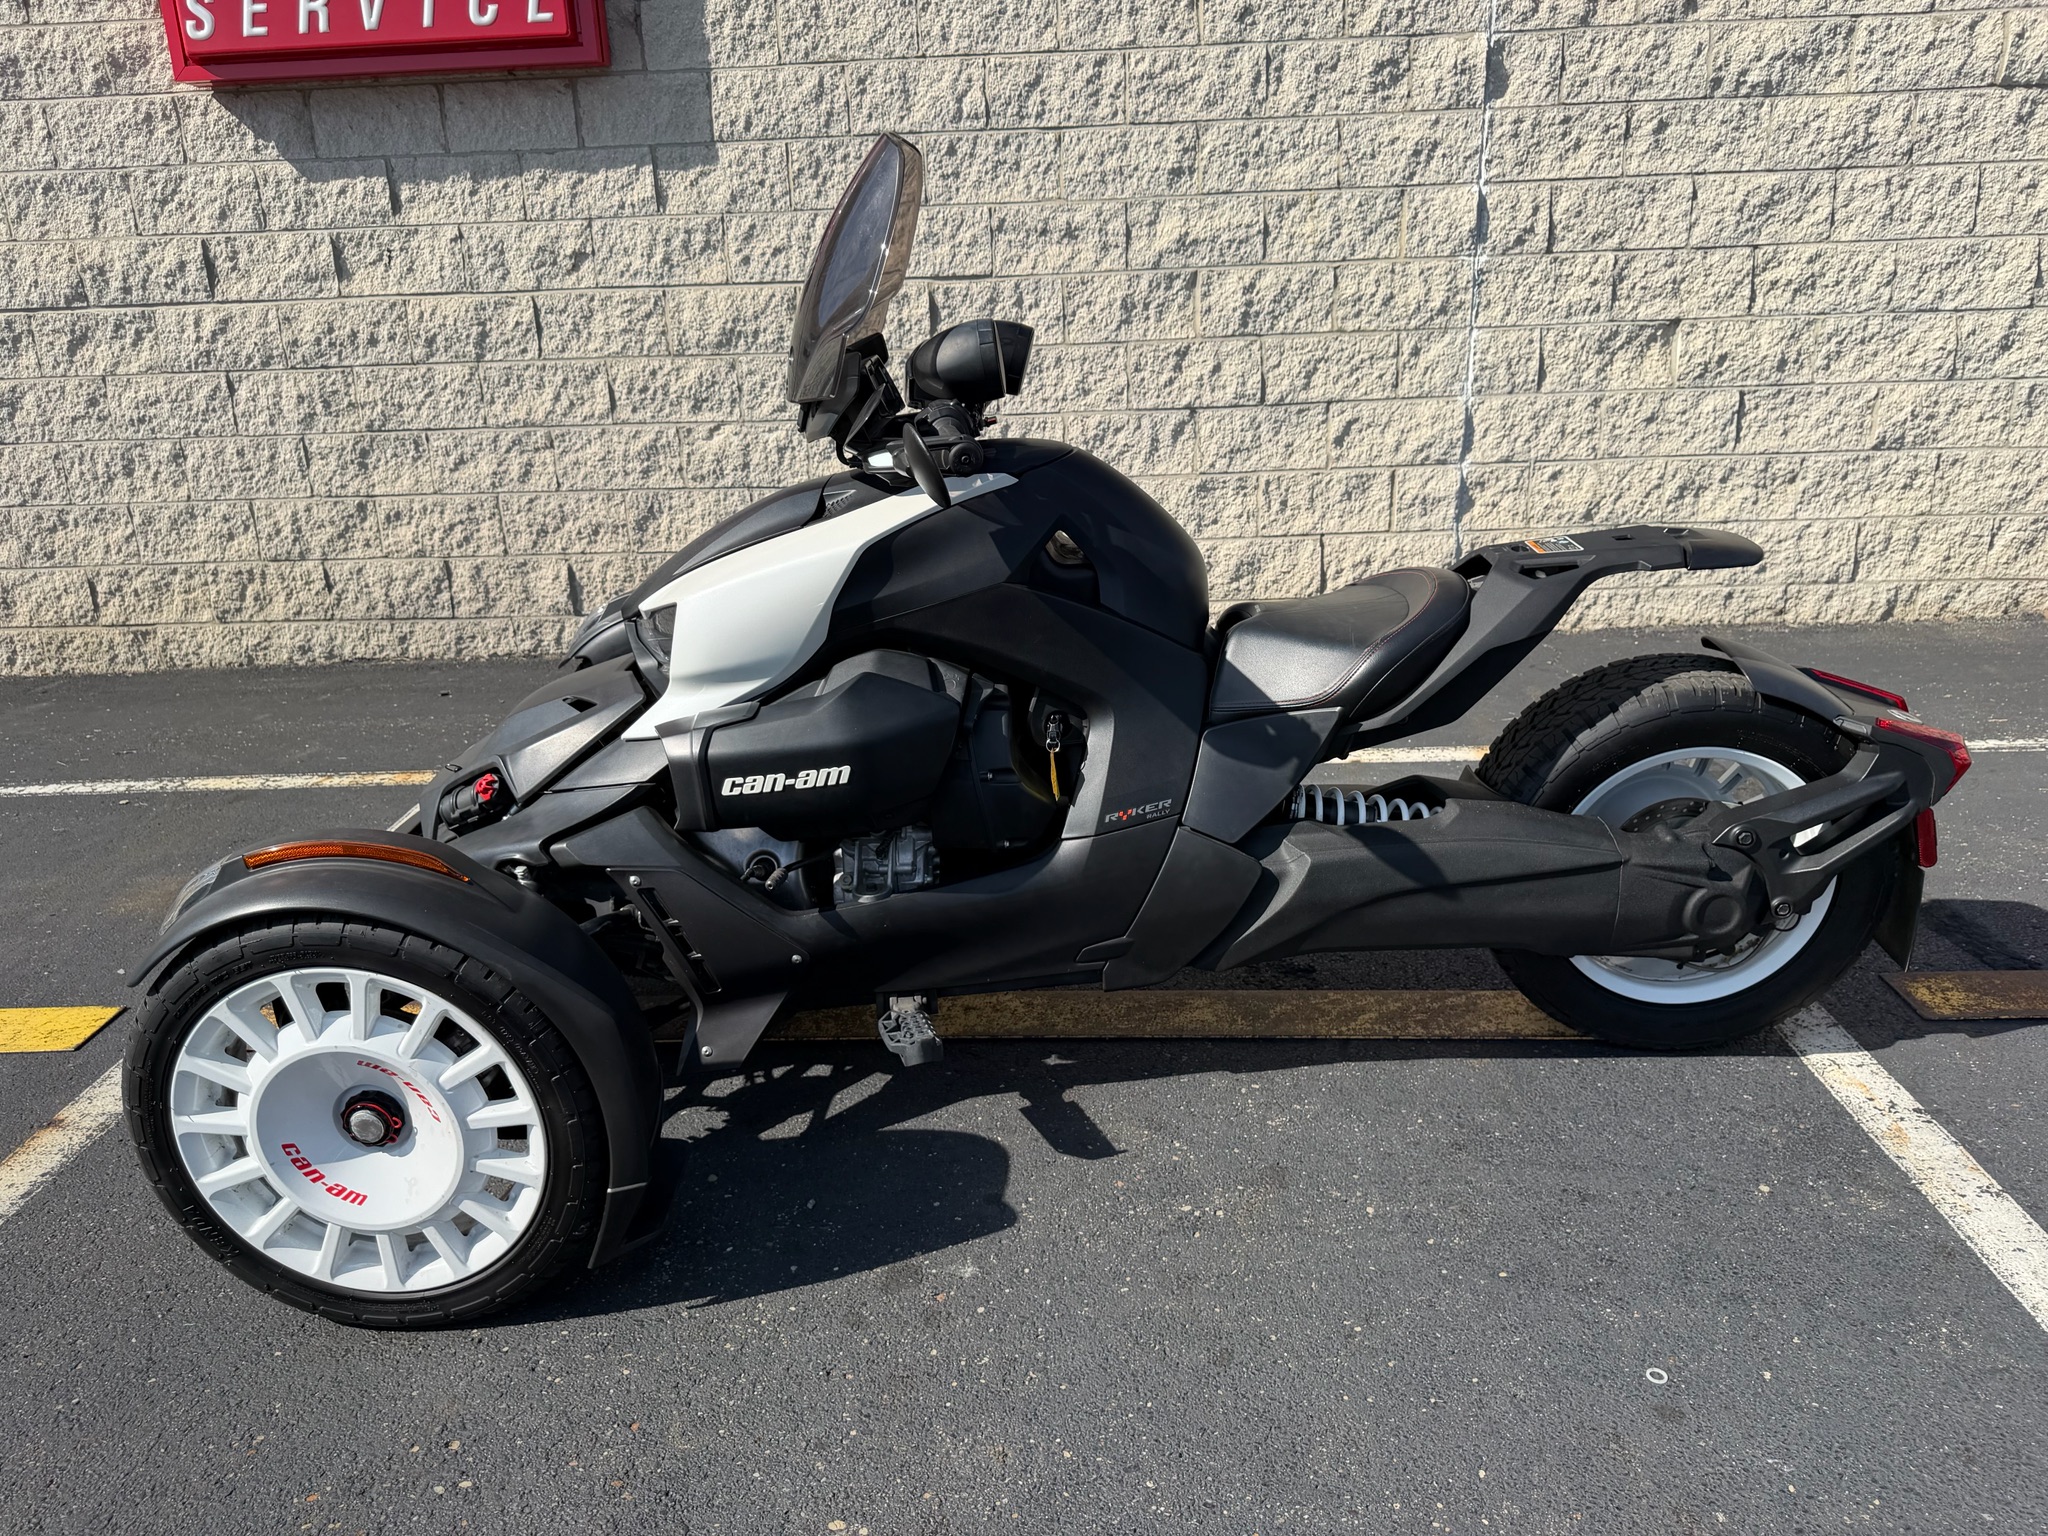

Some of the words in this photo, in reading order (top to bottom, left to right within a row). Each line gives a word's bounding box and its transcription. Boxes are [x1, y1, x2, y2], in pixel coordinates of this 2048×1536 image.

[721, 765, 852, 796] can-am
[1104, 798, 1172, 823] RYKER
[1146, 808, 1171, 820] RALLY
[356, 1059, 442, 1124] can-am
[280, 1142, 369, 1207] can-am
